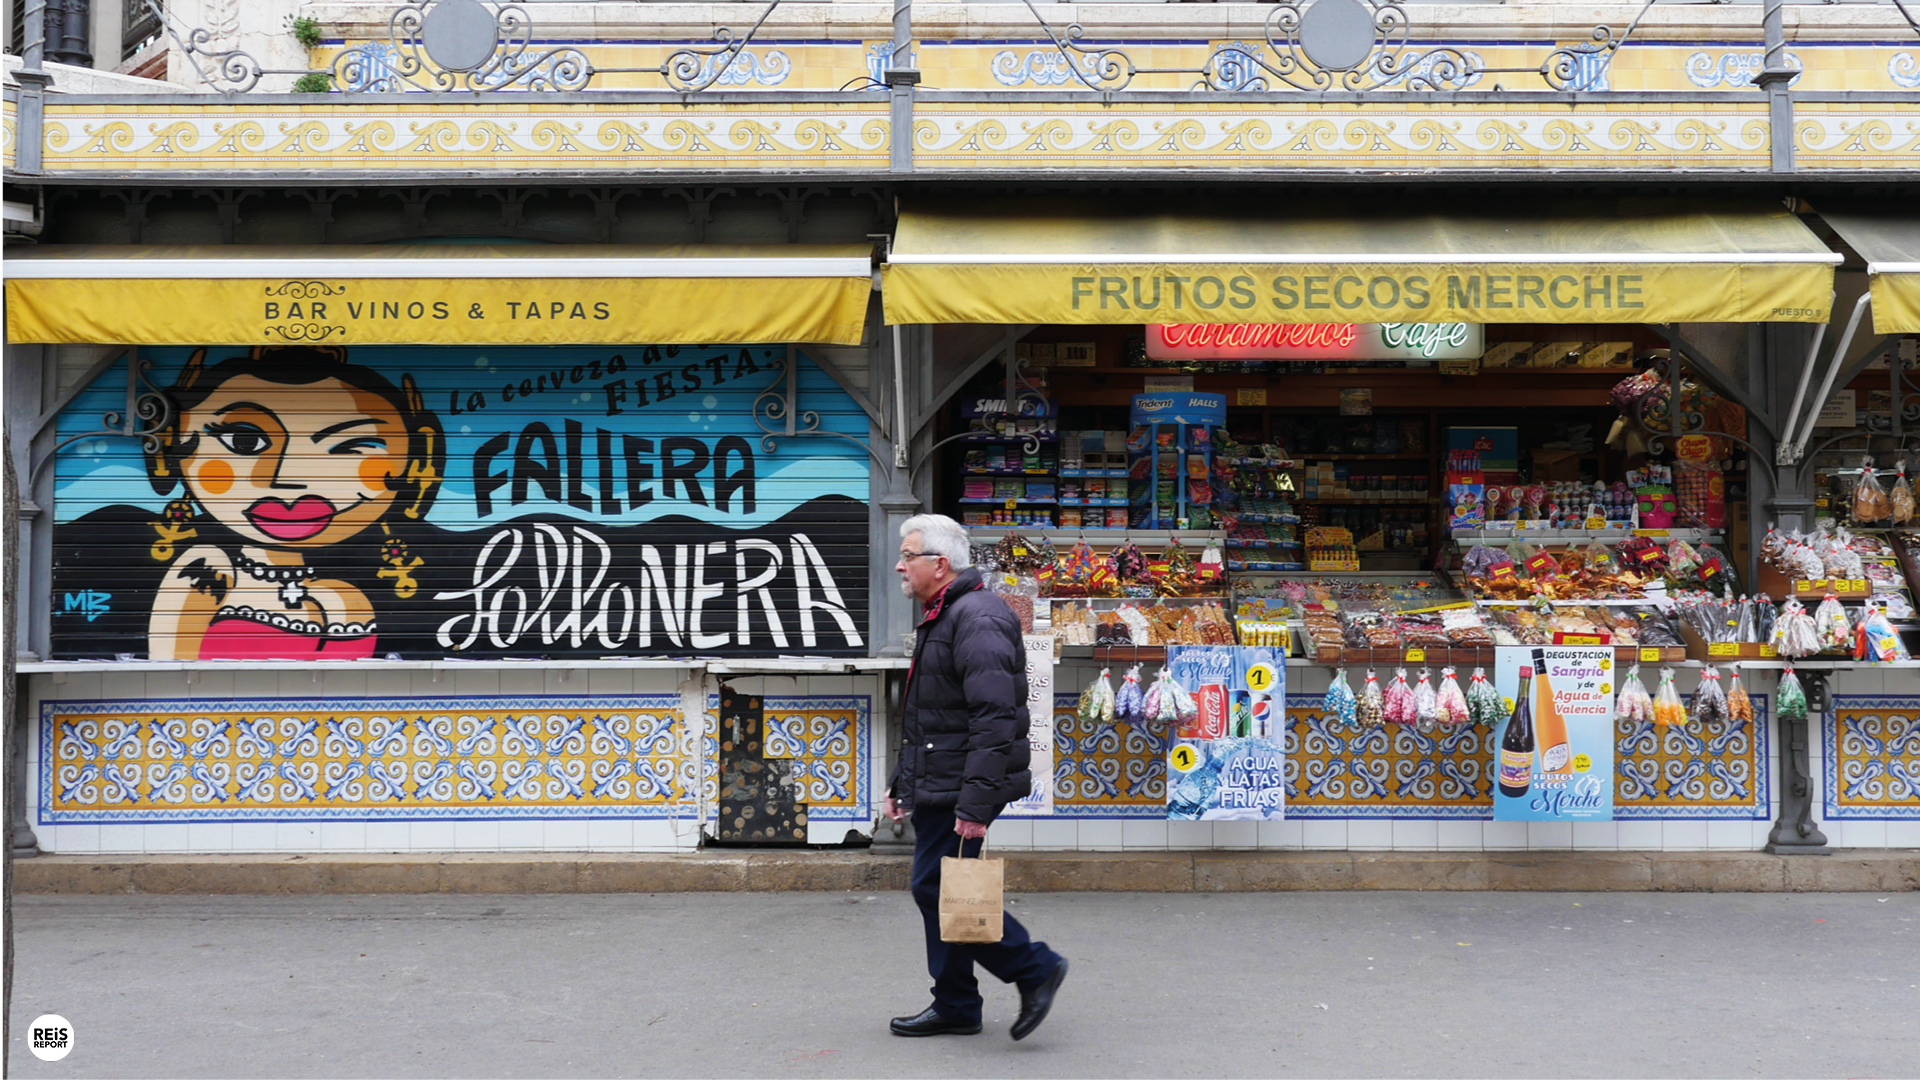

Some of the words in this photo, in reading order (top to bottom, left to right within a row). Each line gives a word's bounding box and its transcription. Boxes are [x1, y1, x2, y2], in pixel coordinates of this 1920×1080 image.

[1071, 275, 1256, 311] FRUTOS
[1272, 275, 1430, 310] SECOS
[1452, 274, 1644, 309] MERCHE
[265, 301, 327, 320] BAR
[347, 301, 449, 320] VINOS
[468, 302, 484, 320] &
[506, 301, 610, 320] TAPAS
[1772, 308, 1814, 316] PUESTO
[1816, 309, 1821, 317] 9
[502, 354, 628, 402] cerveza
[974, 399, 1027, 412] SMIT
[1137, 399, 1174, 409] Trident
[1189, 399, 1218, 408] HALLS
[1680, 439, 1707, 448] Chupa
[1680, 447, 1707, 456] Chups
[473, 418, 756, 518] FALLERA
[1546, 649, 1611, 659] DEGUSTACIÓN
[1251, 670, 1264, 685] 1
[1551, 666, 1604, 679] Sangría
[1555, 690, 1590, 703] Agua
[1556, 704, 1606, 714] Valencia
[1177, 751, 1190, 766] 1
[1231, 757, 1279, 771] AGUA
[1229, 774, 1279, 787] LATAS
[1533, 773, 1574, 781] FRUTOS
[1221, 788, 1279, 808] FRÍAS
[1530, 790, 1603, 817] Merche
